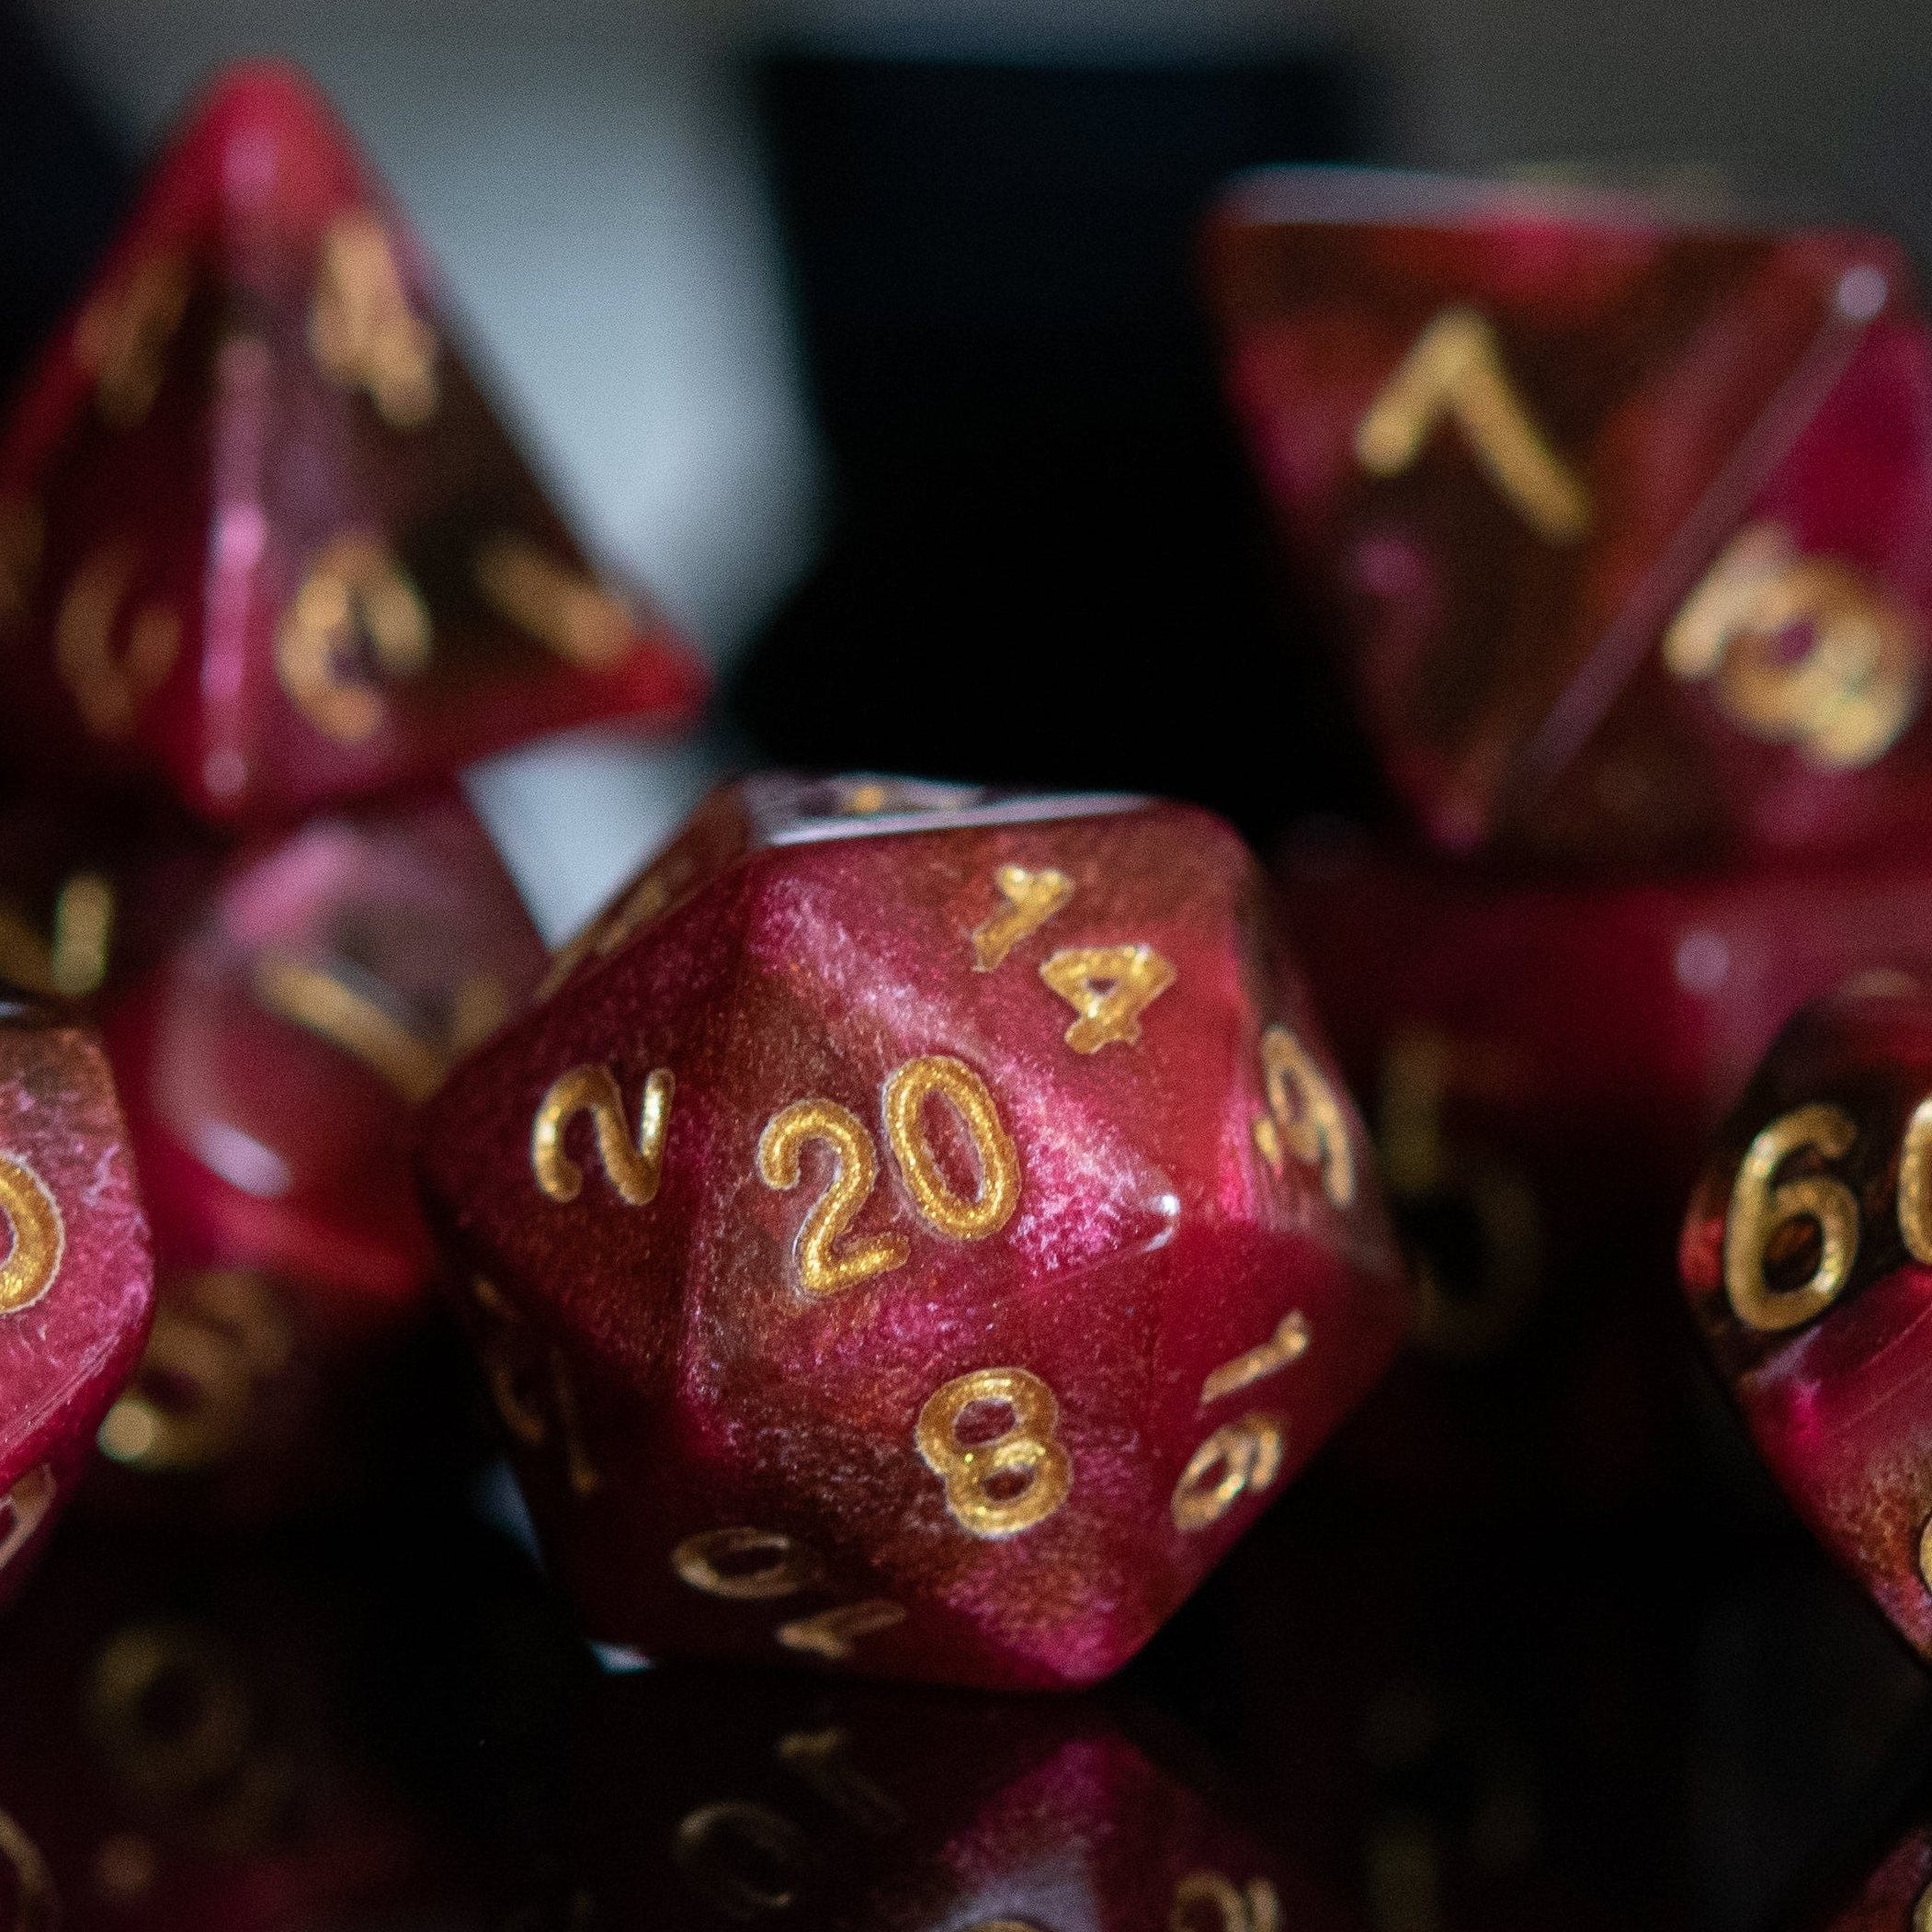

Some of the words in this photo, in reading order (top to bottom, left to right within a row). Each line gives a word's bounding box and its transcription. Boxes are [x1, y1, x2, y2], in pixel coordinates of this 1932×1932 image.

[530, 1063, 676, 1207] 2
[757, 1054, 1023, 1298] 20
[1724, 1096, 1932, 1332] 6
[915, 1367, 1076, 1540] 8
